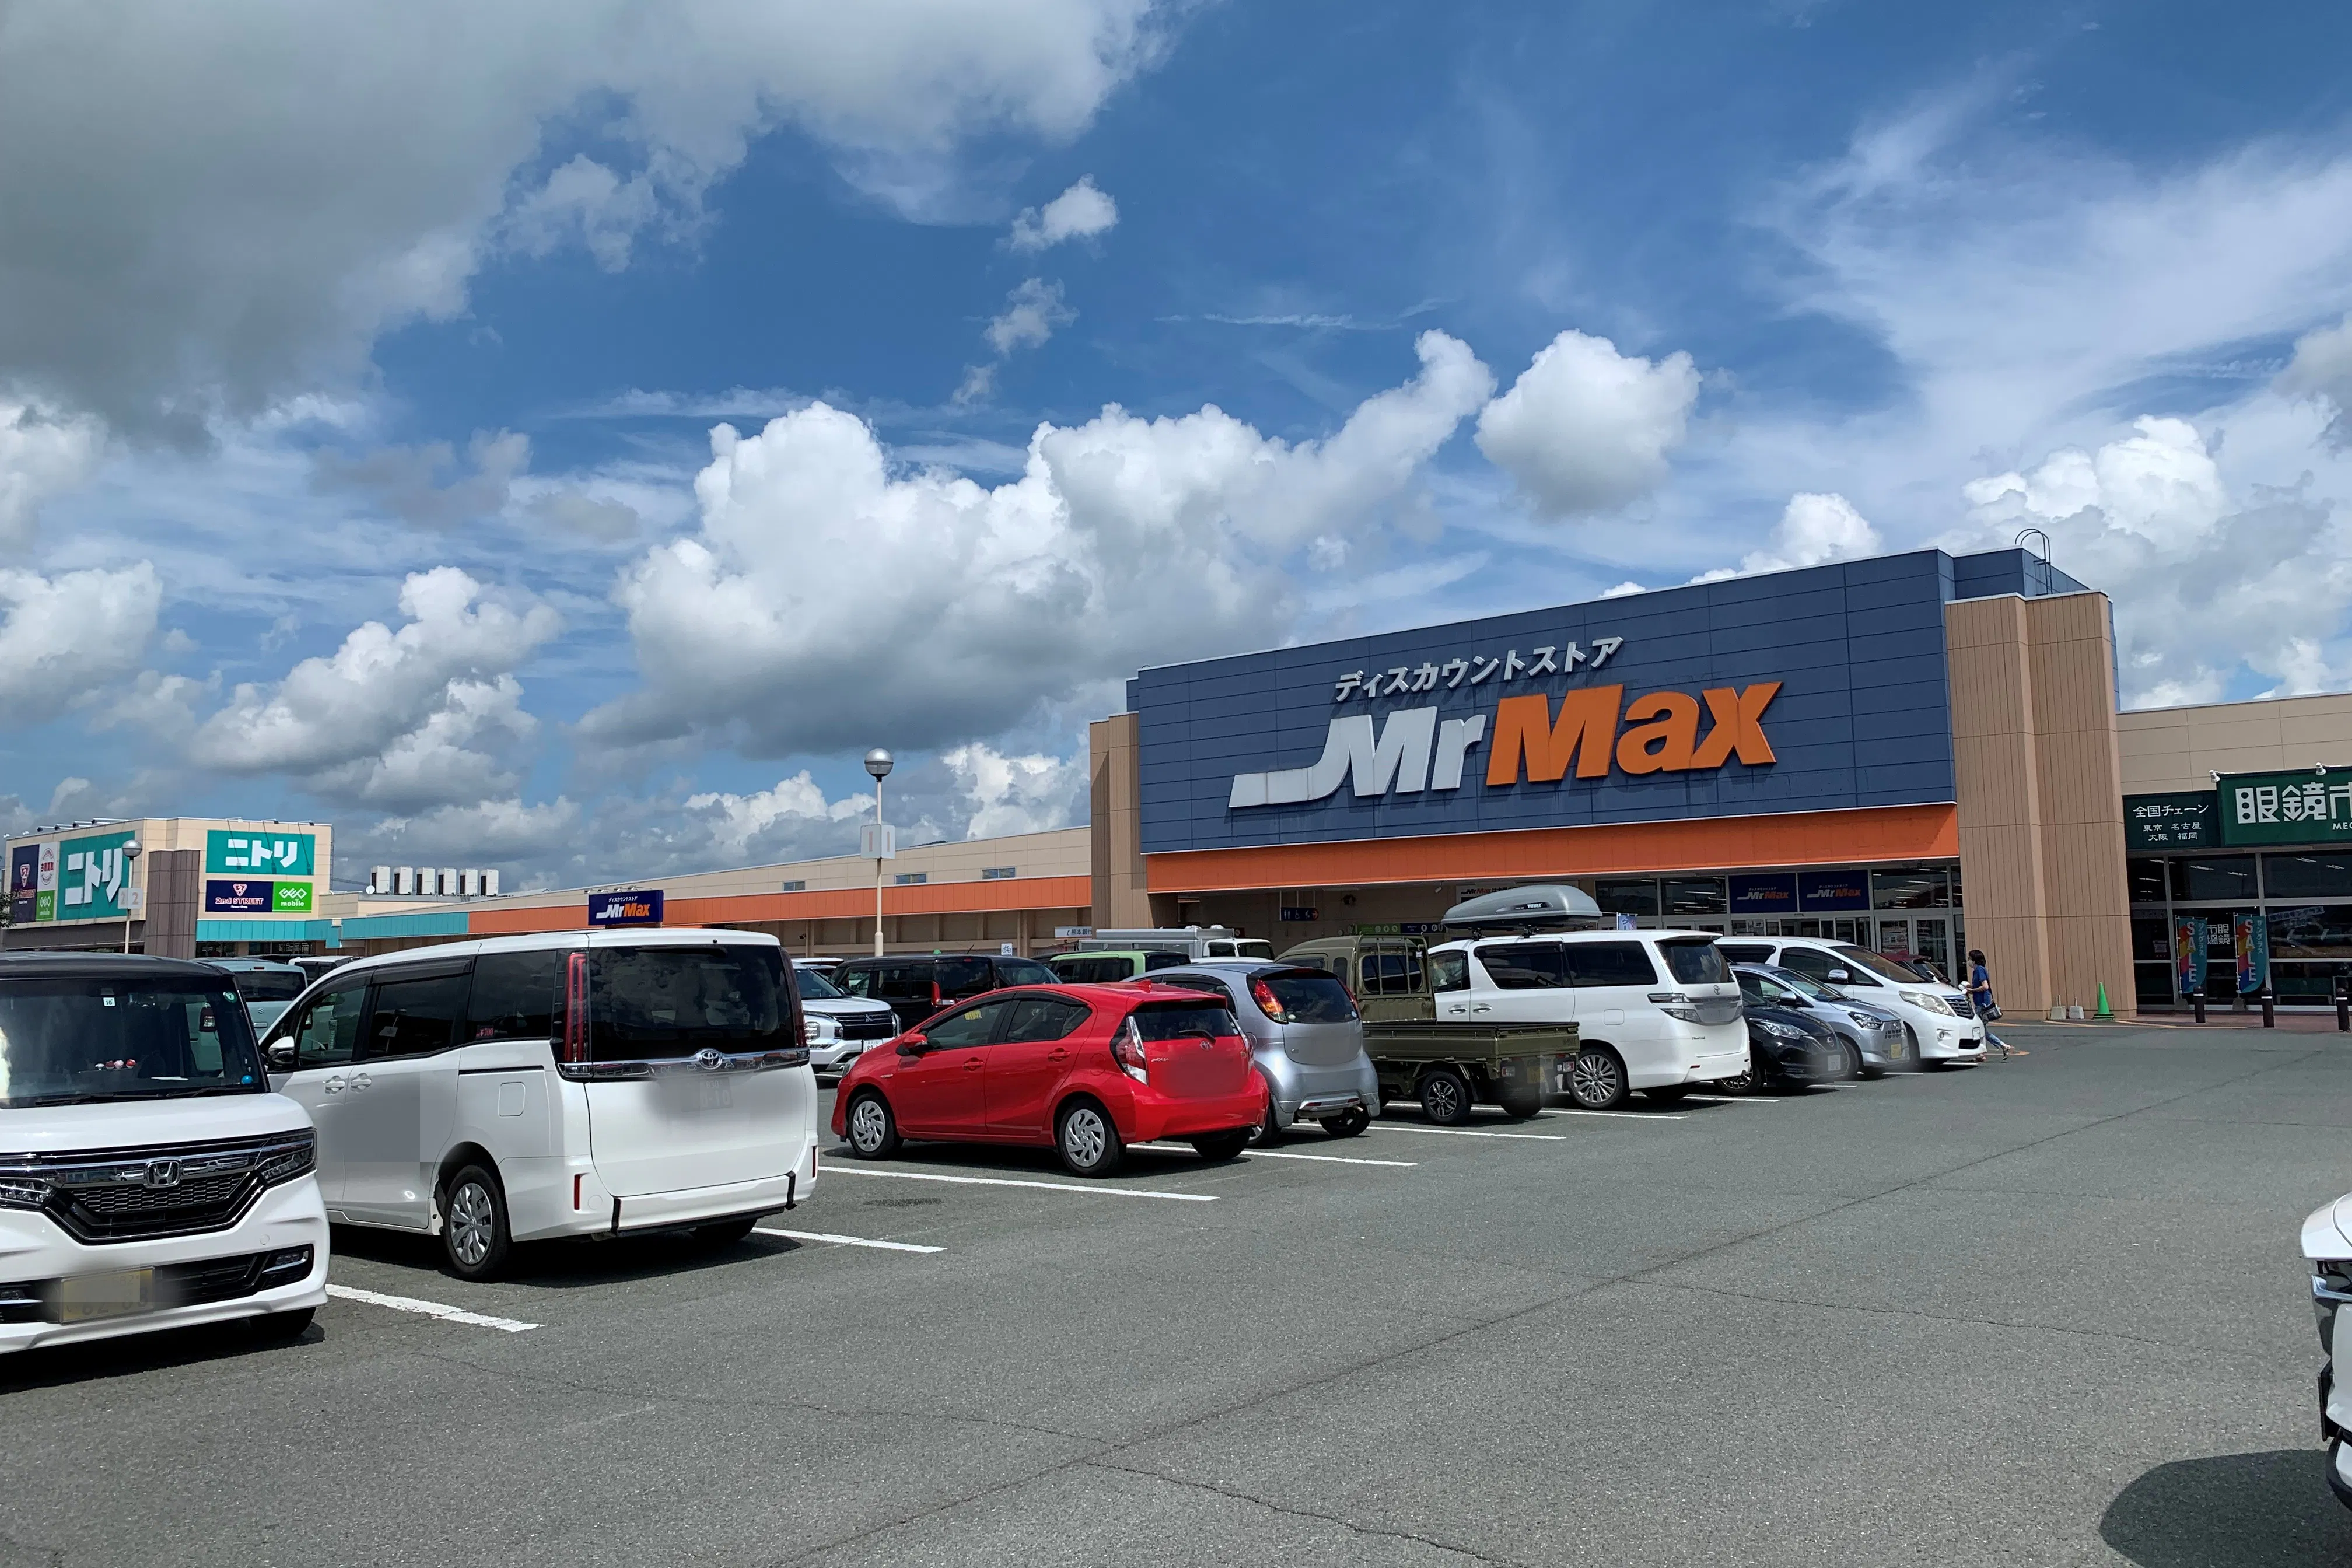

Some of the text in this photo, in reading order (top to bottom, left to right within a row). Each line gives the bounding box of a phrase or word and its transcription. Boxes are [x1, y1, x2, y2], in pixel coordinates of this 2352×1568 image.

[1335, 636, 1624, 702] ディスカウントストア
[1228, 681, 1783, 808] MrMax
[2133, 804, 2208, 818] 全国チェーン
[2143, 822, 2202, 832] 東京 名古屋
[2177, 832, 2197, 840] 福岡
[225, 839, 298, 869] ニトリ
[65, 848, 123, 905] ニトリ
[132, 891, 139, 905] 2
[278, 887, 307, 899] GEO
[1737, 891, 1789, 900] MrMax
[1807, 888, 1861, 898] MrMax
[281, 899, 304, 907] mobile
[596, 902, 651, 919] MrMax
[2186, 922, 2197, 982] SALE
[2245, 919, 2257, 981] SALE
